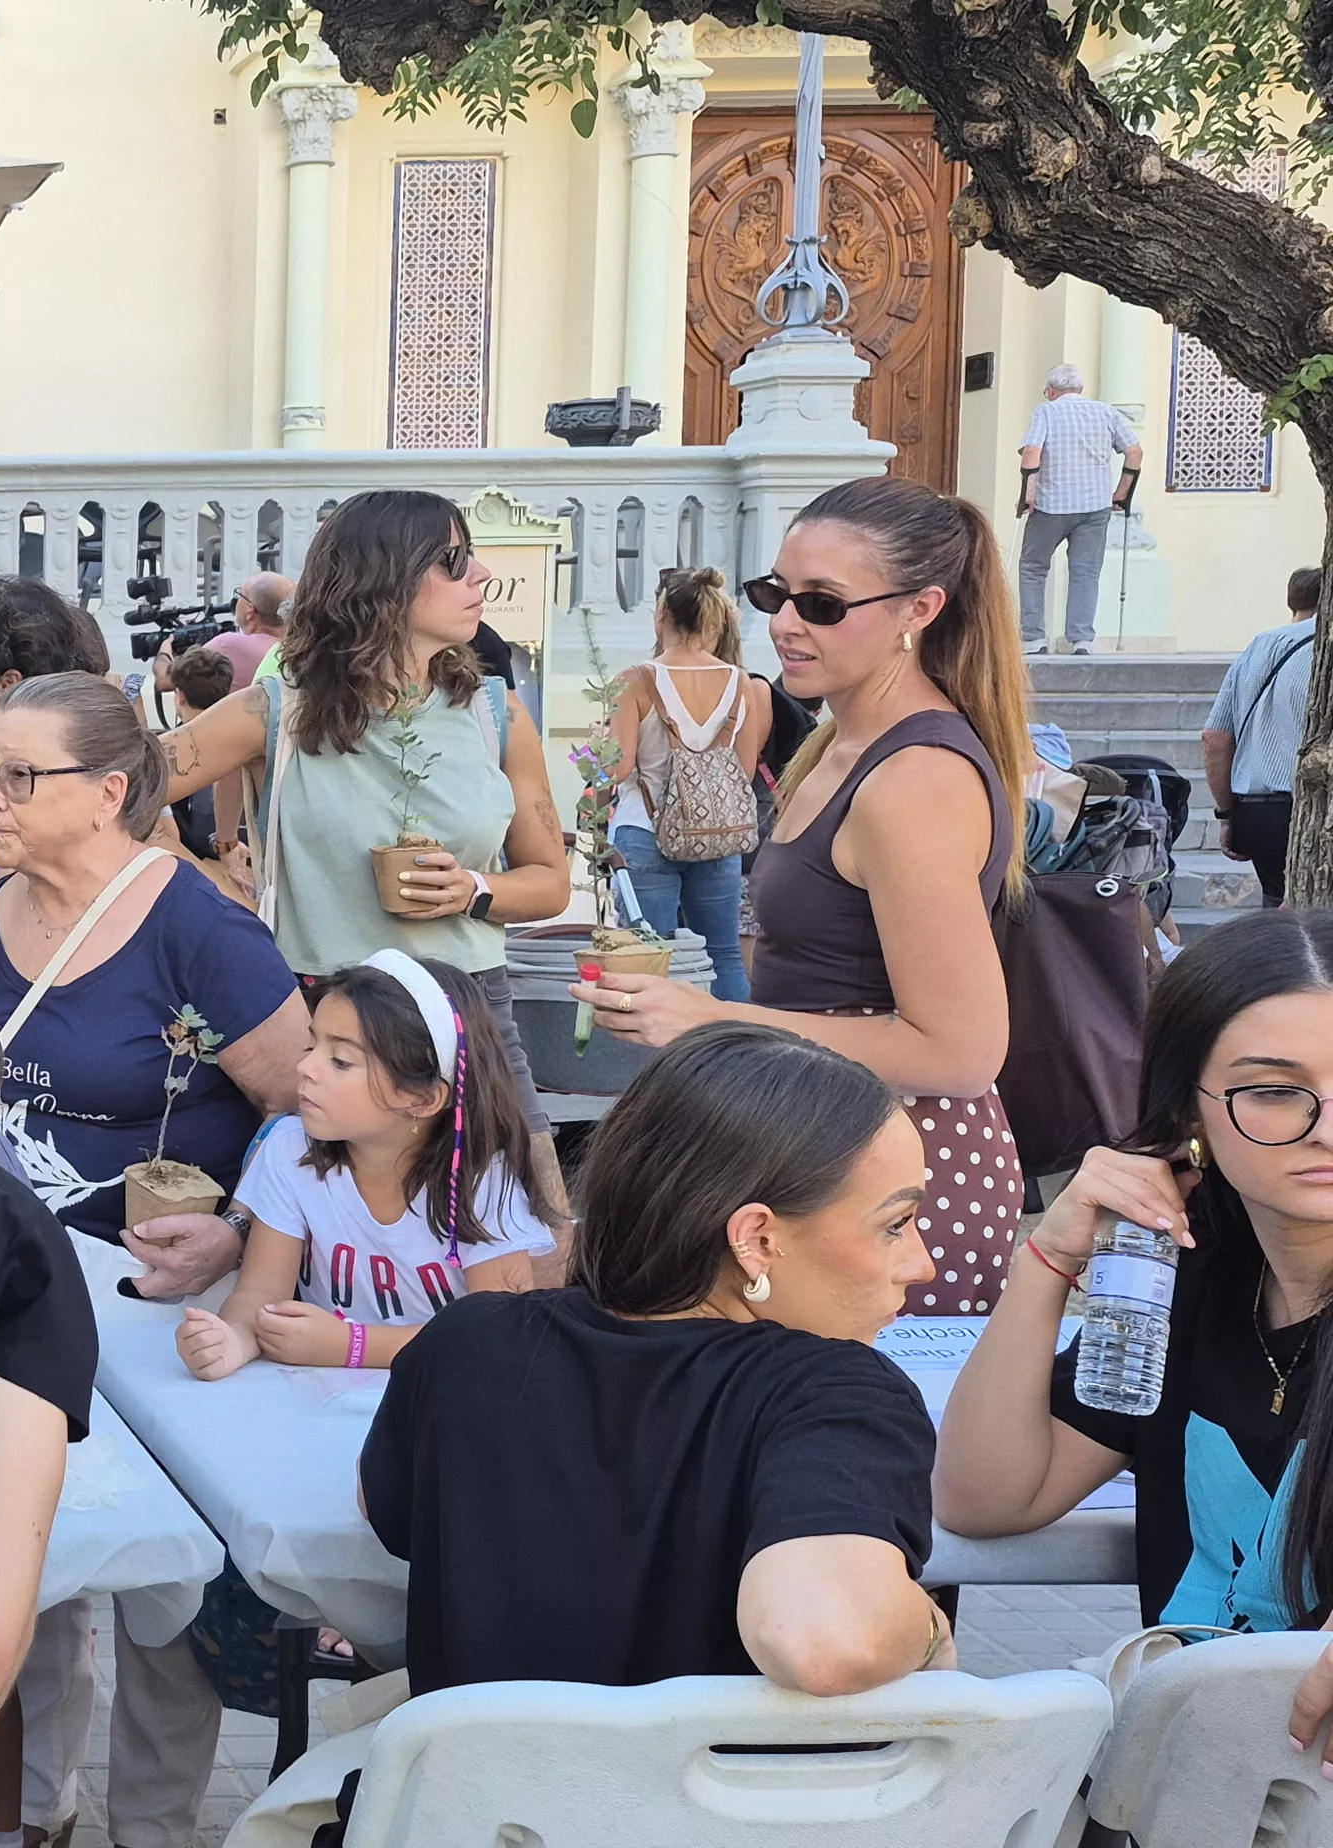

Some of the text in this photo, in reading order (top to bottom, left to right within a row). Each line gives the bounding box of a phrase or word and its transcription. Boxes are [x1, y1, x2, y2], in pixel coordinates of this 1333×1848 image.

[483, 577, 526, 603] or
[2, 1057, 52, 1088] Bella
[33, 1093, 116, 1121] Donna
[894, 1326, 978, 1341] leche
